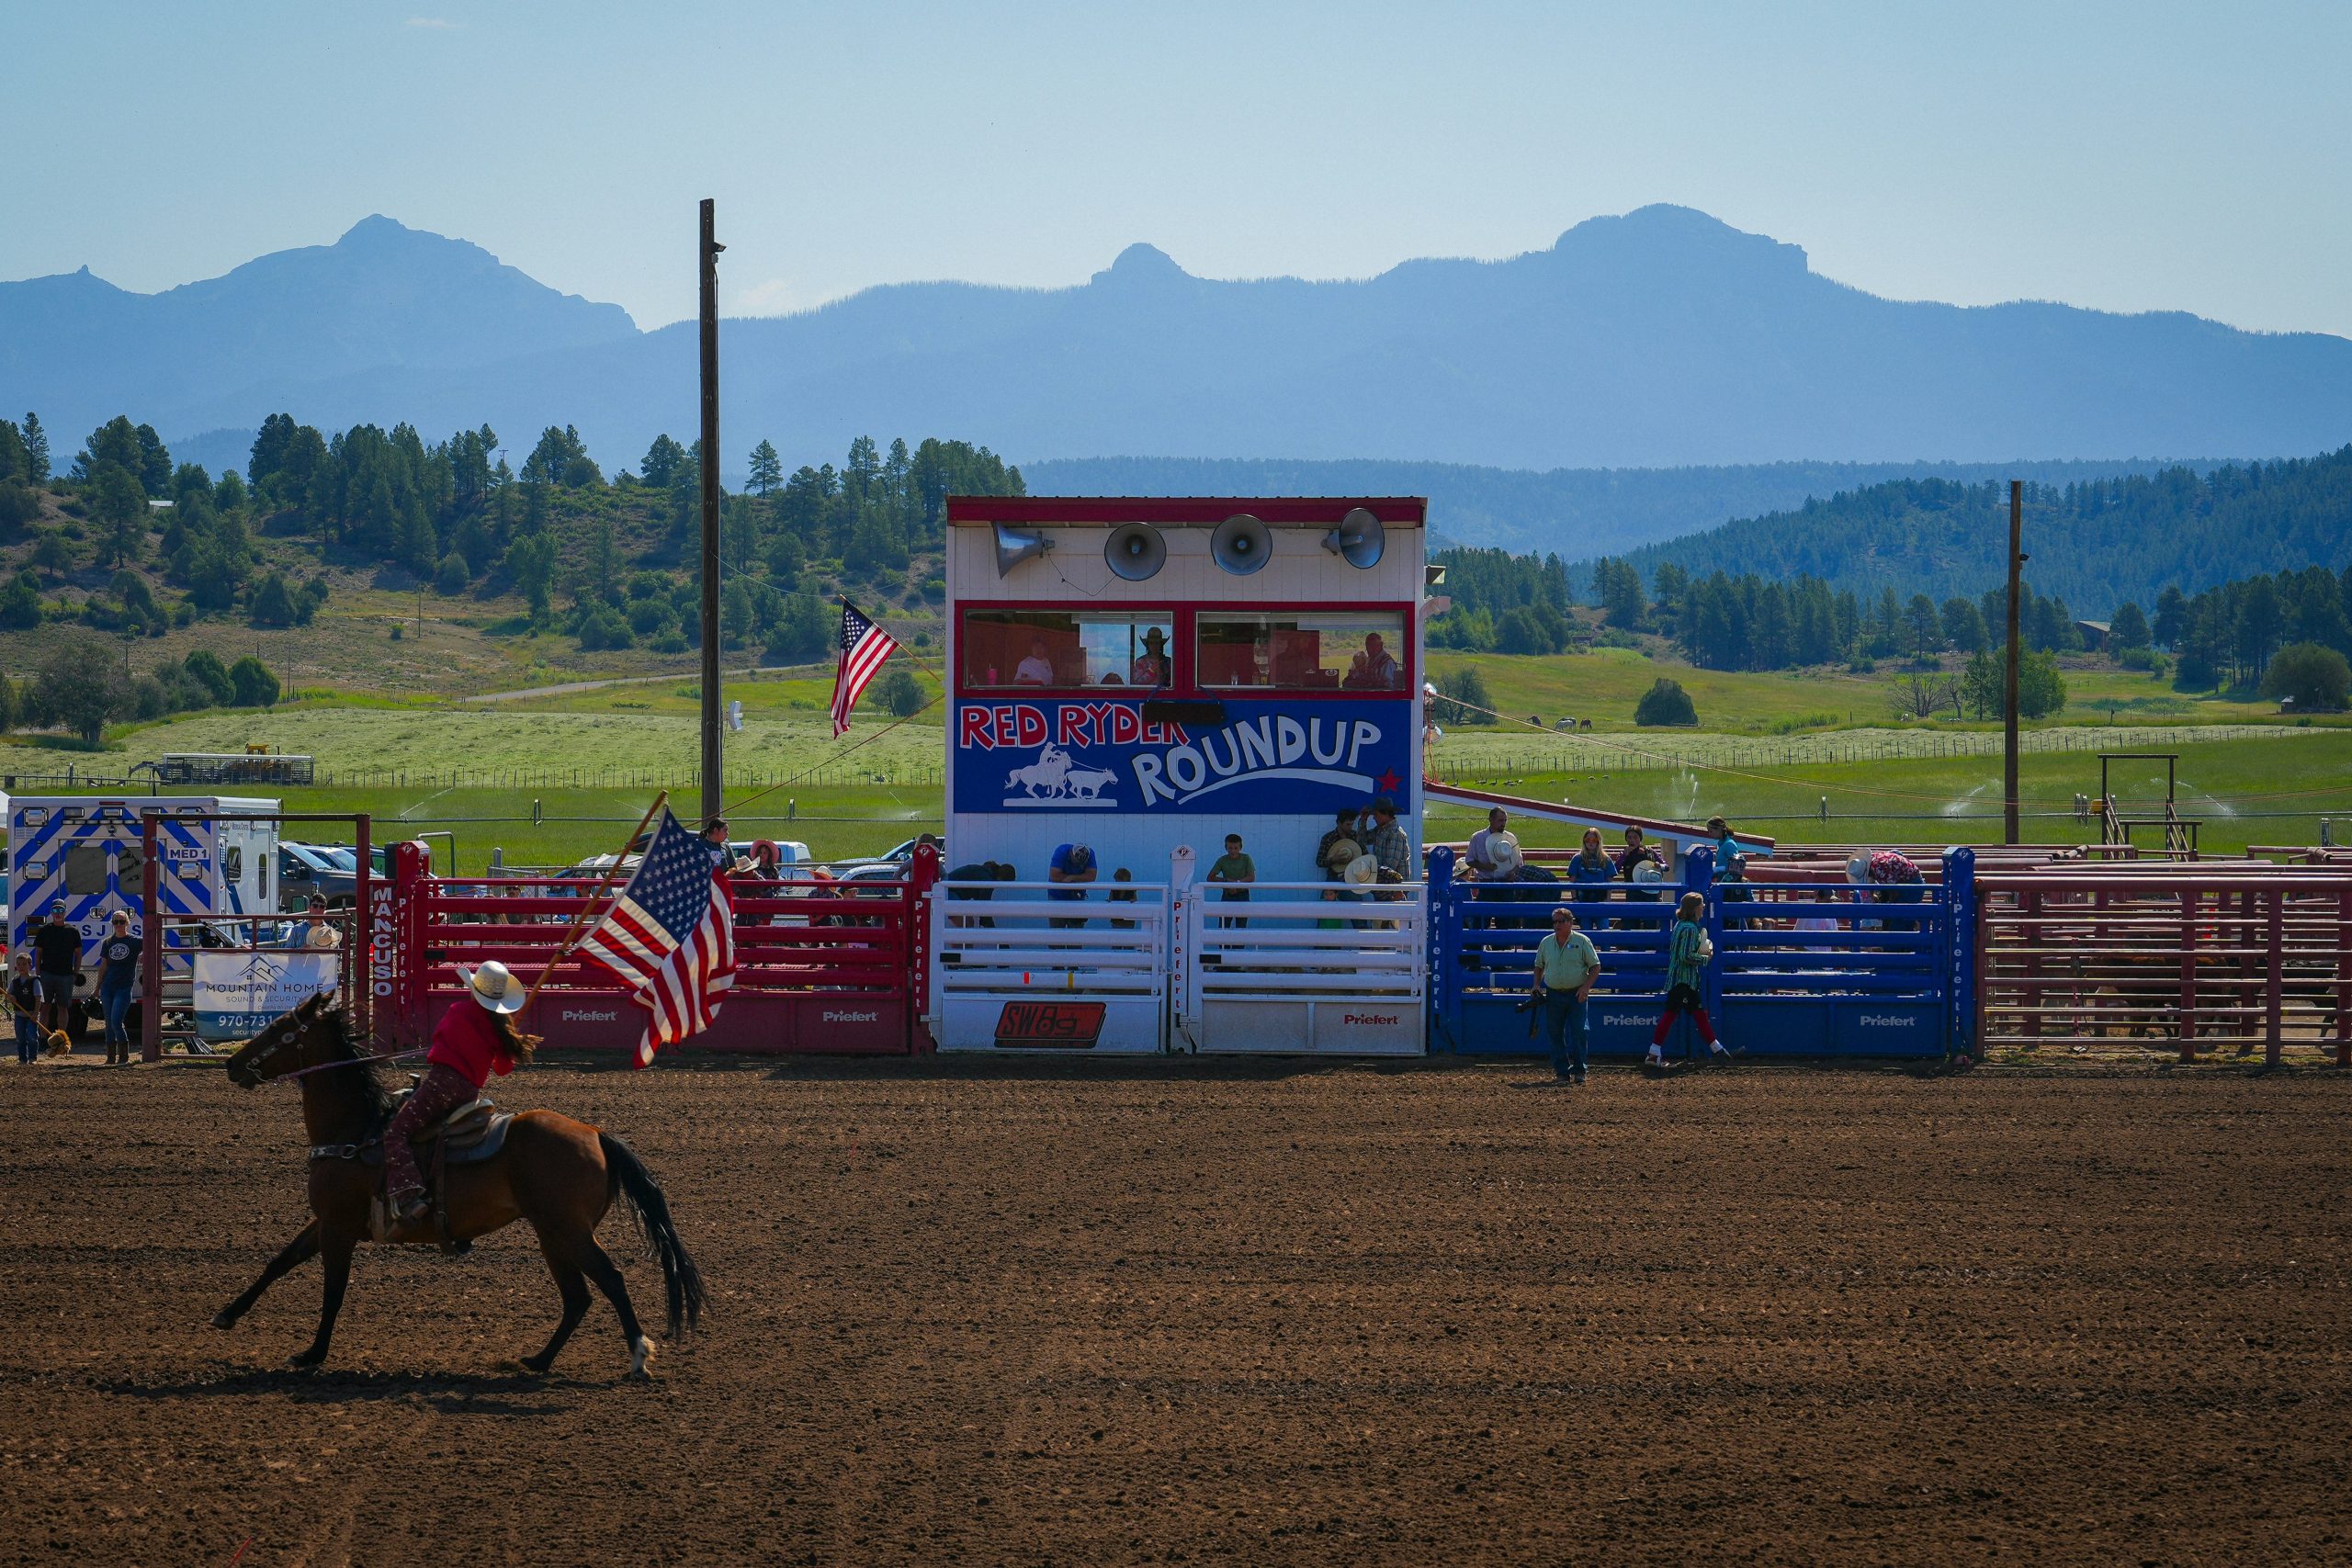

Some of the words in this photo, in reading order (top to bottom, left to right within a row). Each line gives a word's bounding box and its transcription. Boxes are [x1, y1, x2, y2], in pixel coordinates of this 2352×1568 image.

[960, 705, 1048, 751] RED
[1131, 715, 1382, 807] ROUNDUP
[170, 849, 198, 859] MED
[201, 849, 207, 859] 1
[373, 887, 392, 997] MANCUSO
[399, 897, 407, 1005] Priefert
[914, 900, 923, 1008] Priefert
[1173, 902, 1182, 1009] Priefert
[1432, 902, 1442, 1010] Priefert
[1953, 903, 1962, 1011] Priefert
[206, 984, 277, 993] MOUNTAIN
[283, 983, 323, 993] HOME
[219, 1015, 273, 1027] 970-731
[562, 1010, 616, 1021] Priefert
[823, 1010, 877, 1021] Priefert
[1344, 1014, 1398, 1025] Priefert
[1603, 1014, 1657, 1025] Priefert
[1860, 1014, 1915, 1026] Priefert
